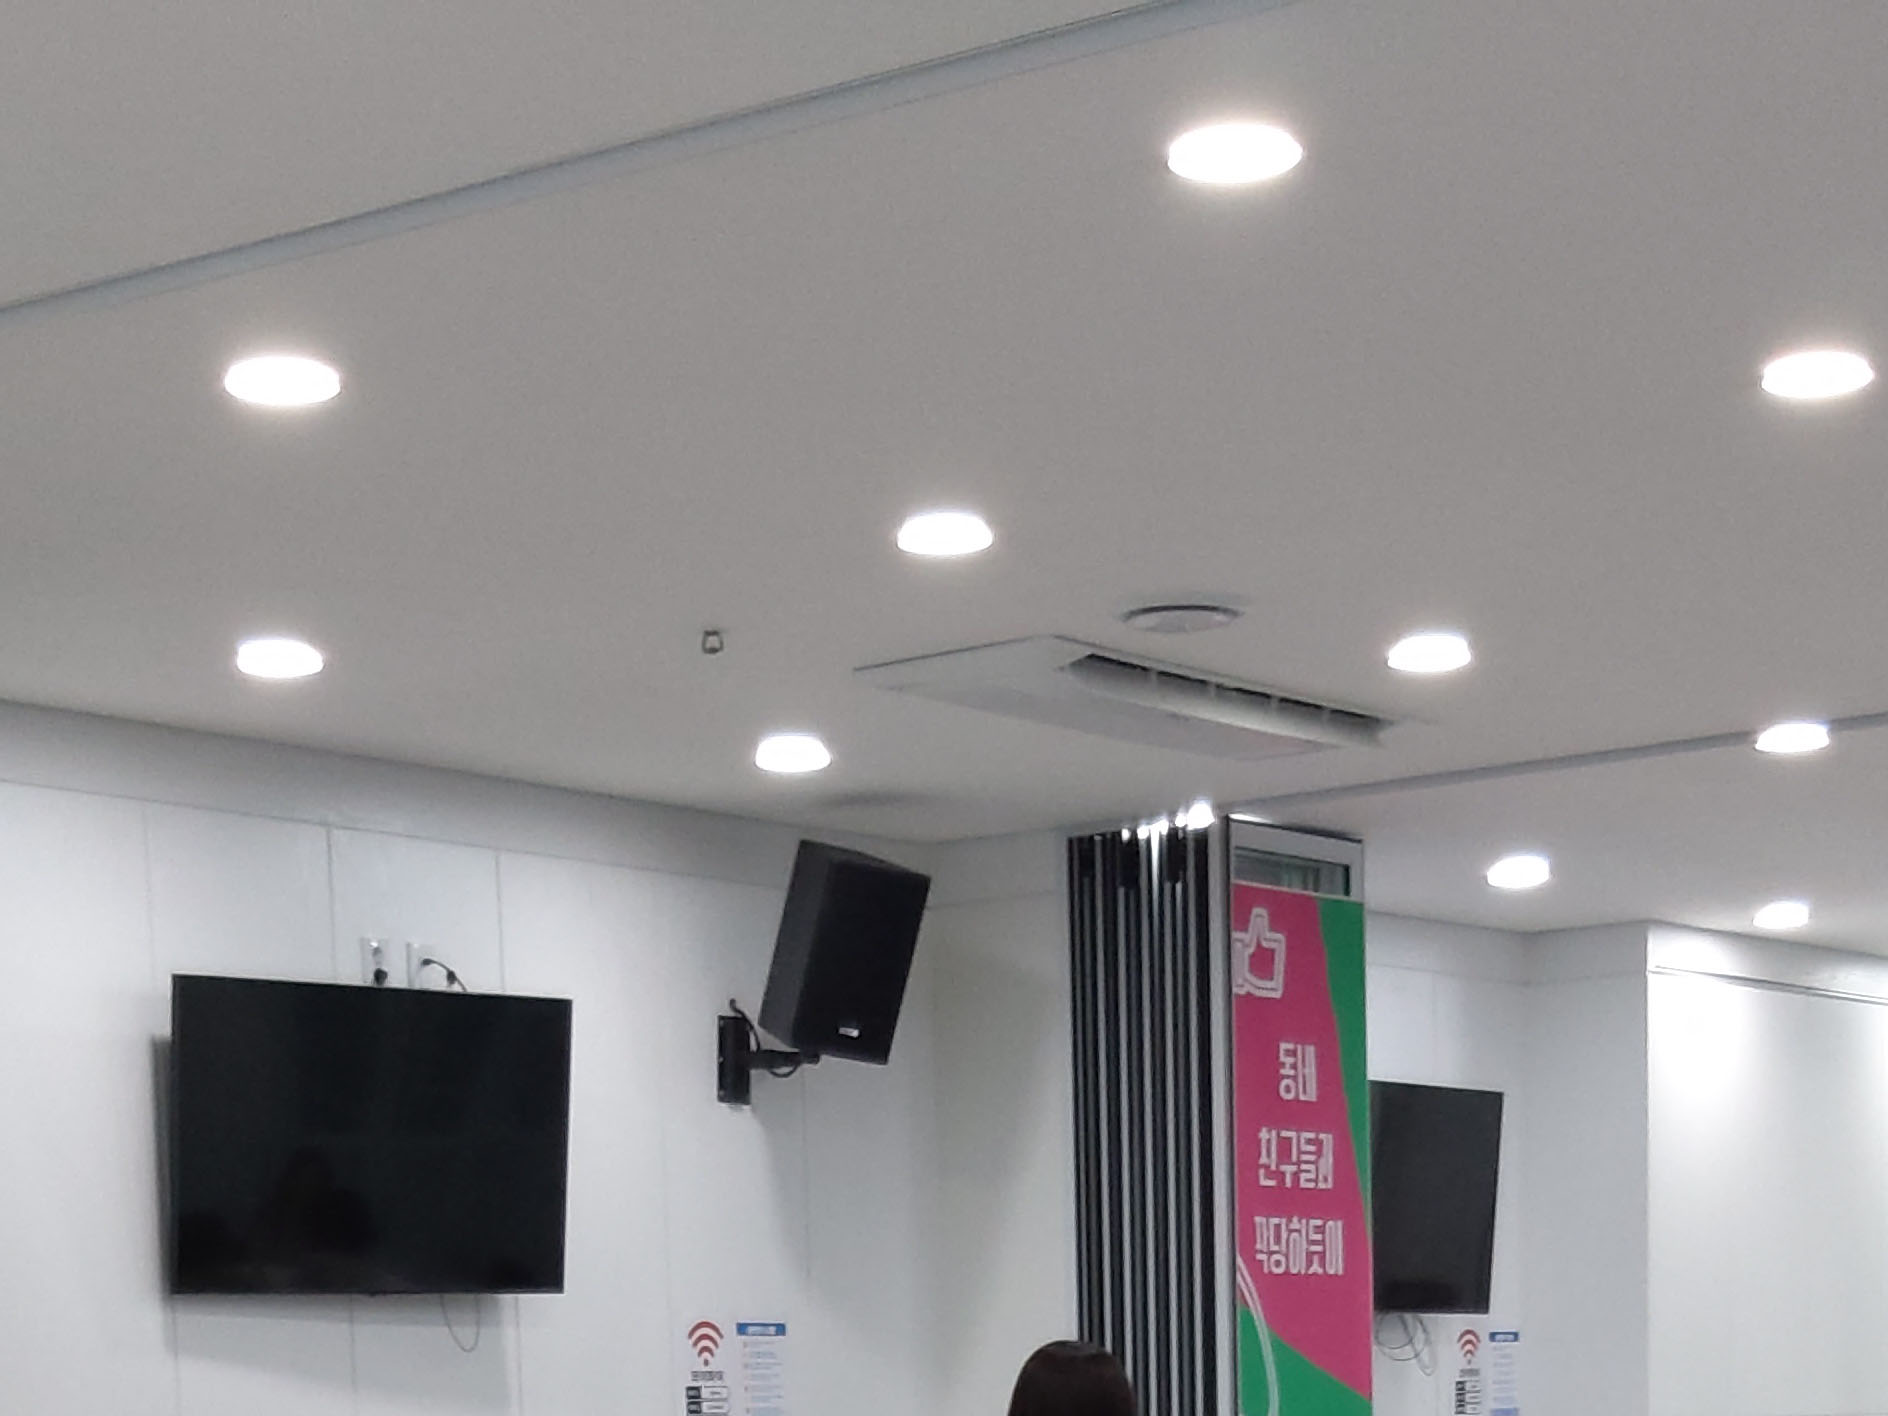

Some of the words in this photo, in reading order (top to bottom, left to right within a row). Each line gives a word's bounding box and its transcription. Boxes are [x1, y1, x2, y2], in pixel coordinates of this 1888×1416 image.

[1278, 1042, 1318, 1102] 동네
[1258, 1126, 1334, 1190] 친구들과
[1253, 1214, 1345, 1276] 작당하듯이
